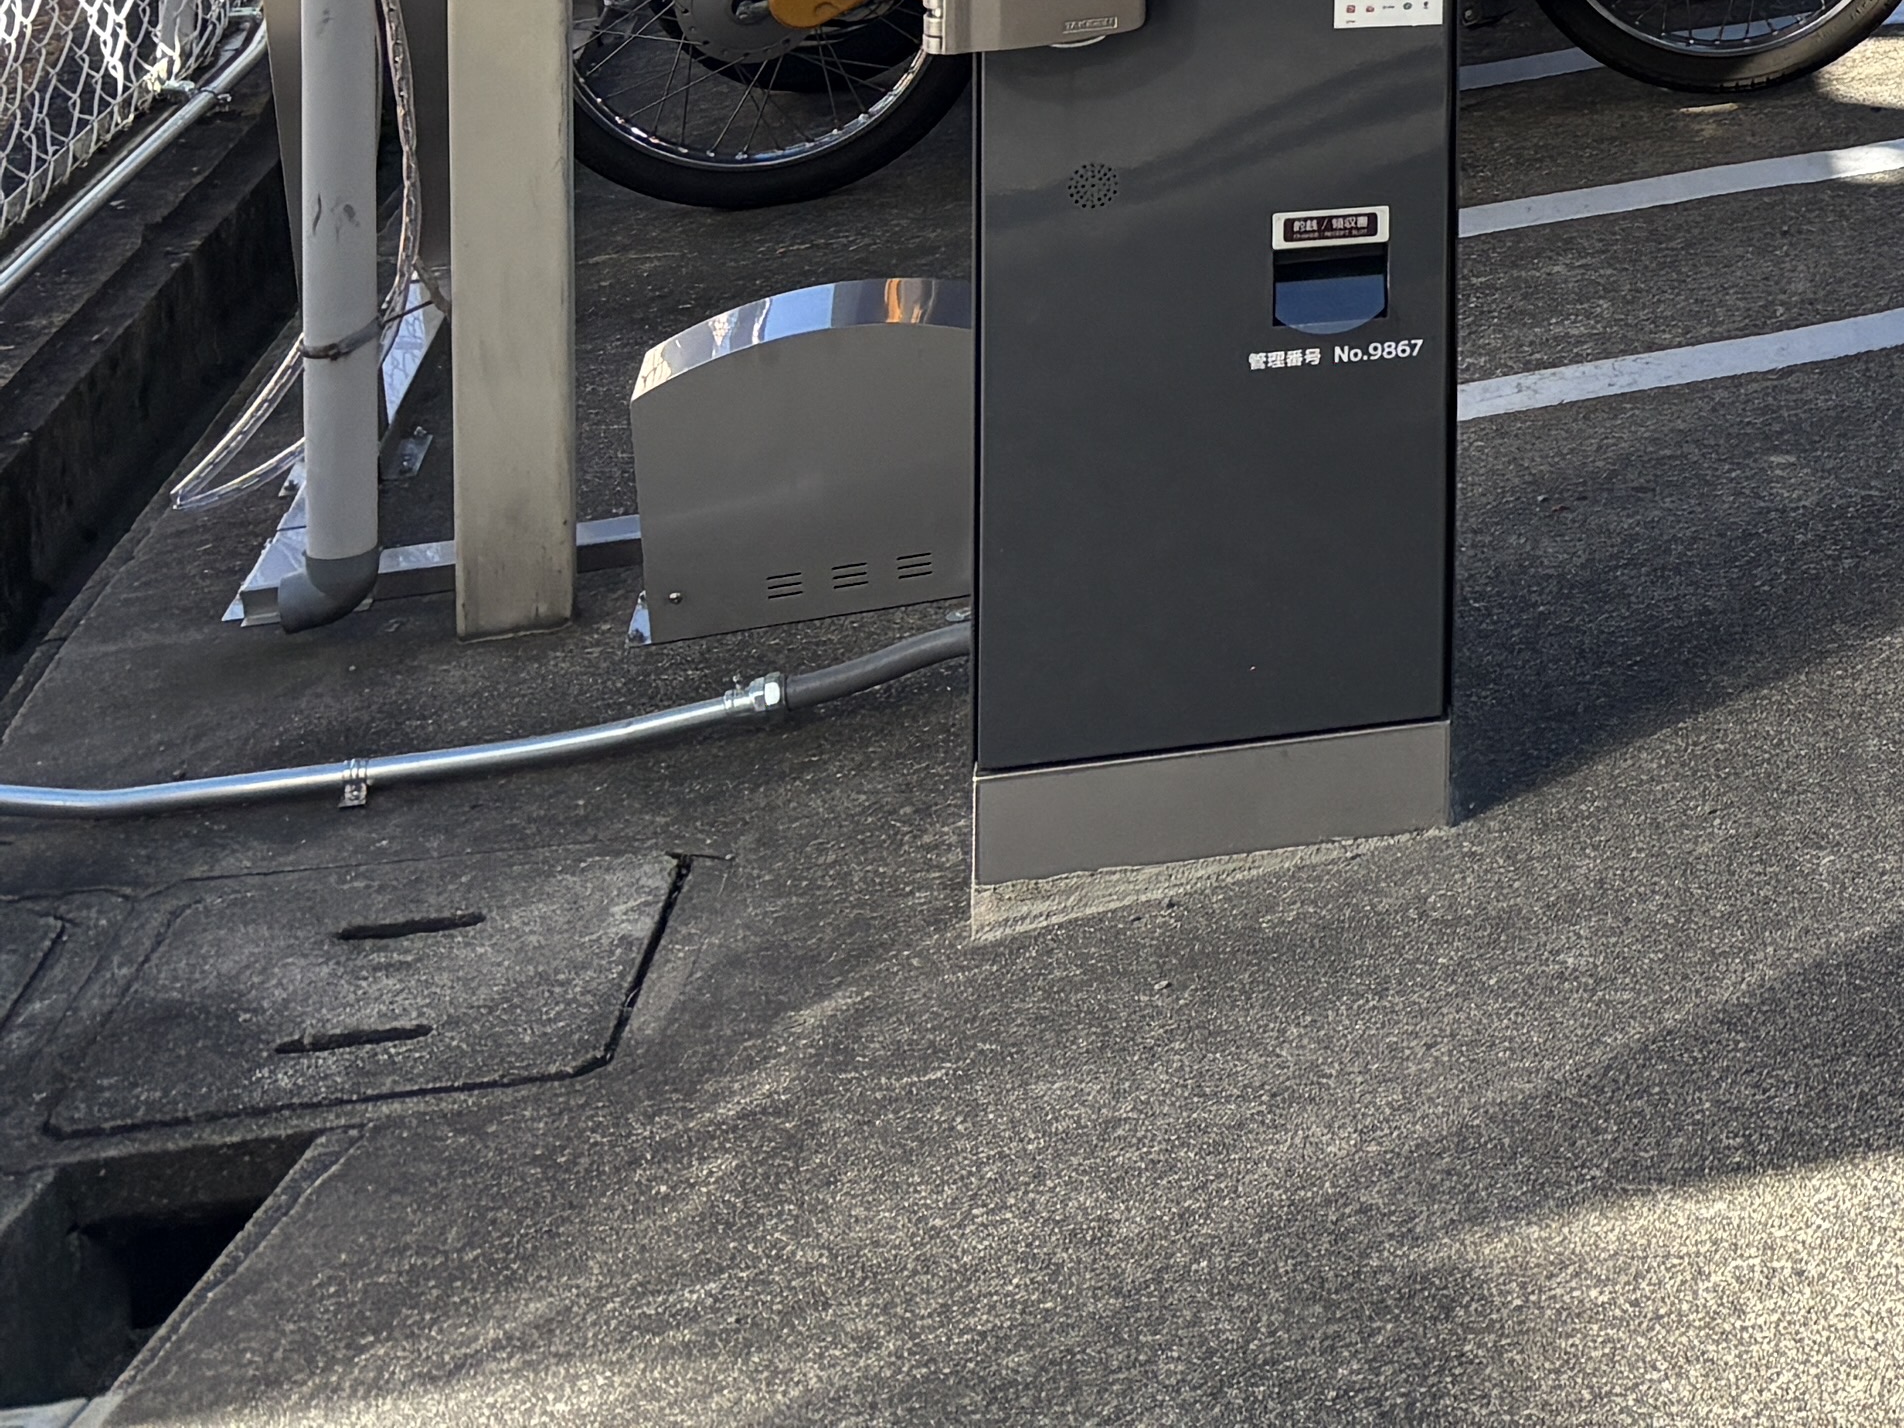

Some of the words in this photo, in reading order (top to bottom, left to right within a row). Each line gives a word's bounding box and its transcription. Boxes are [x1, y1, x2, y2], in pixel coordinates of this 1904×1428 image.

[1249, 348, 1321, 370] 管理番号
[1334, 339, 1424, 363] No.9867
